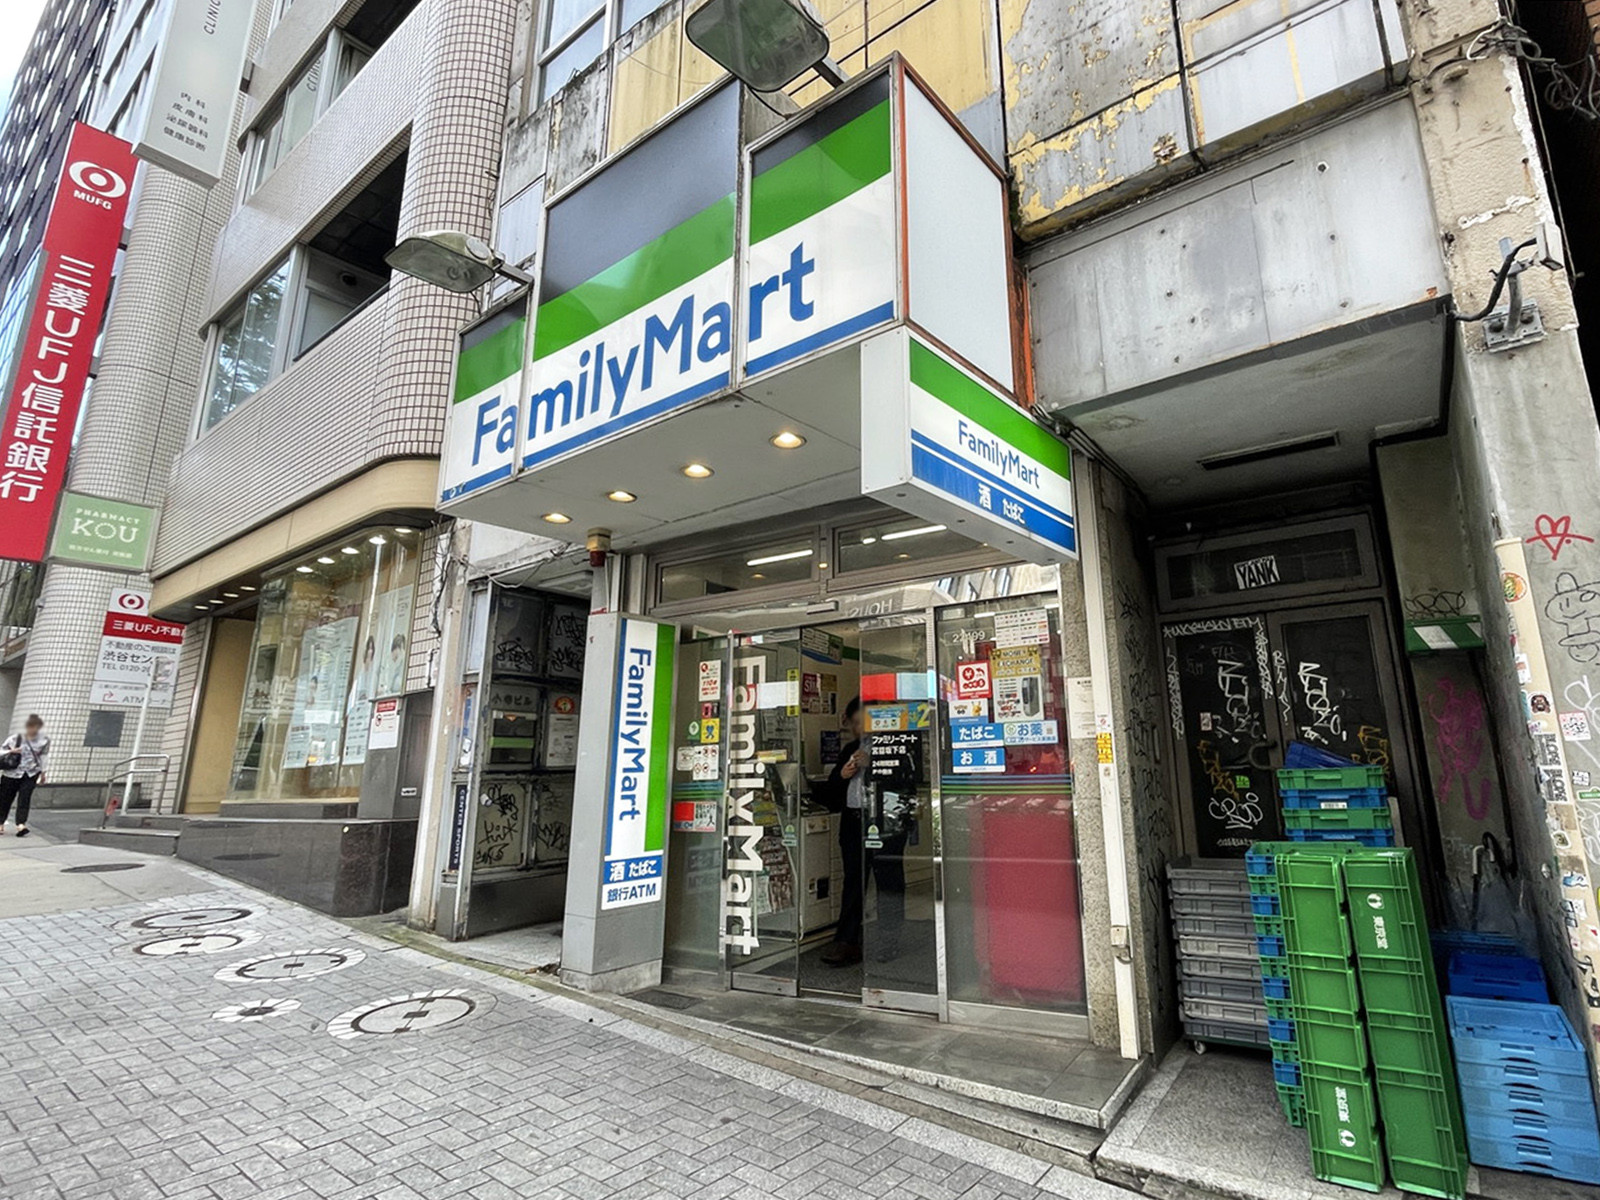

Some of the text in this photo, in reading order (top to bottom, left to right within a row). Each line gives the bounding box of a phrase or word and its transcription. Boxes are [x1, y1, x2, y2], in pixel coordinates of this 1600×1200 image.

[73, 189, 112, 211] MUFG
[471, 242, 816, 467] FamilyMart
[0, 254, 95, 502] 三菱UFJ信託銀行
[958, 419, 1040, 489] FamilyMart
[978, 482, 1026, 524] 酒 たばこ
[71, 517, 139, 543] KOU
[102, 662, 117, 671] TEL
[103, 650, 154, 664] 渋谷セン
[619, 648, 652, 821] FamilyMart
[871, 734, 918, 744] ファミリーマート
[959, 726, 995, 741] たばこ
[1017, 723, 1042, 737] お薬
[960, 750, 997, 765] お酒
[609, 859, 657, 882] 酒 たばこ
[606, 882, 657, 903] 銀行ATM
